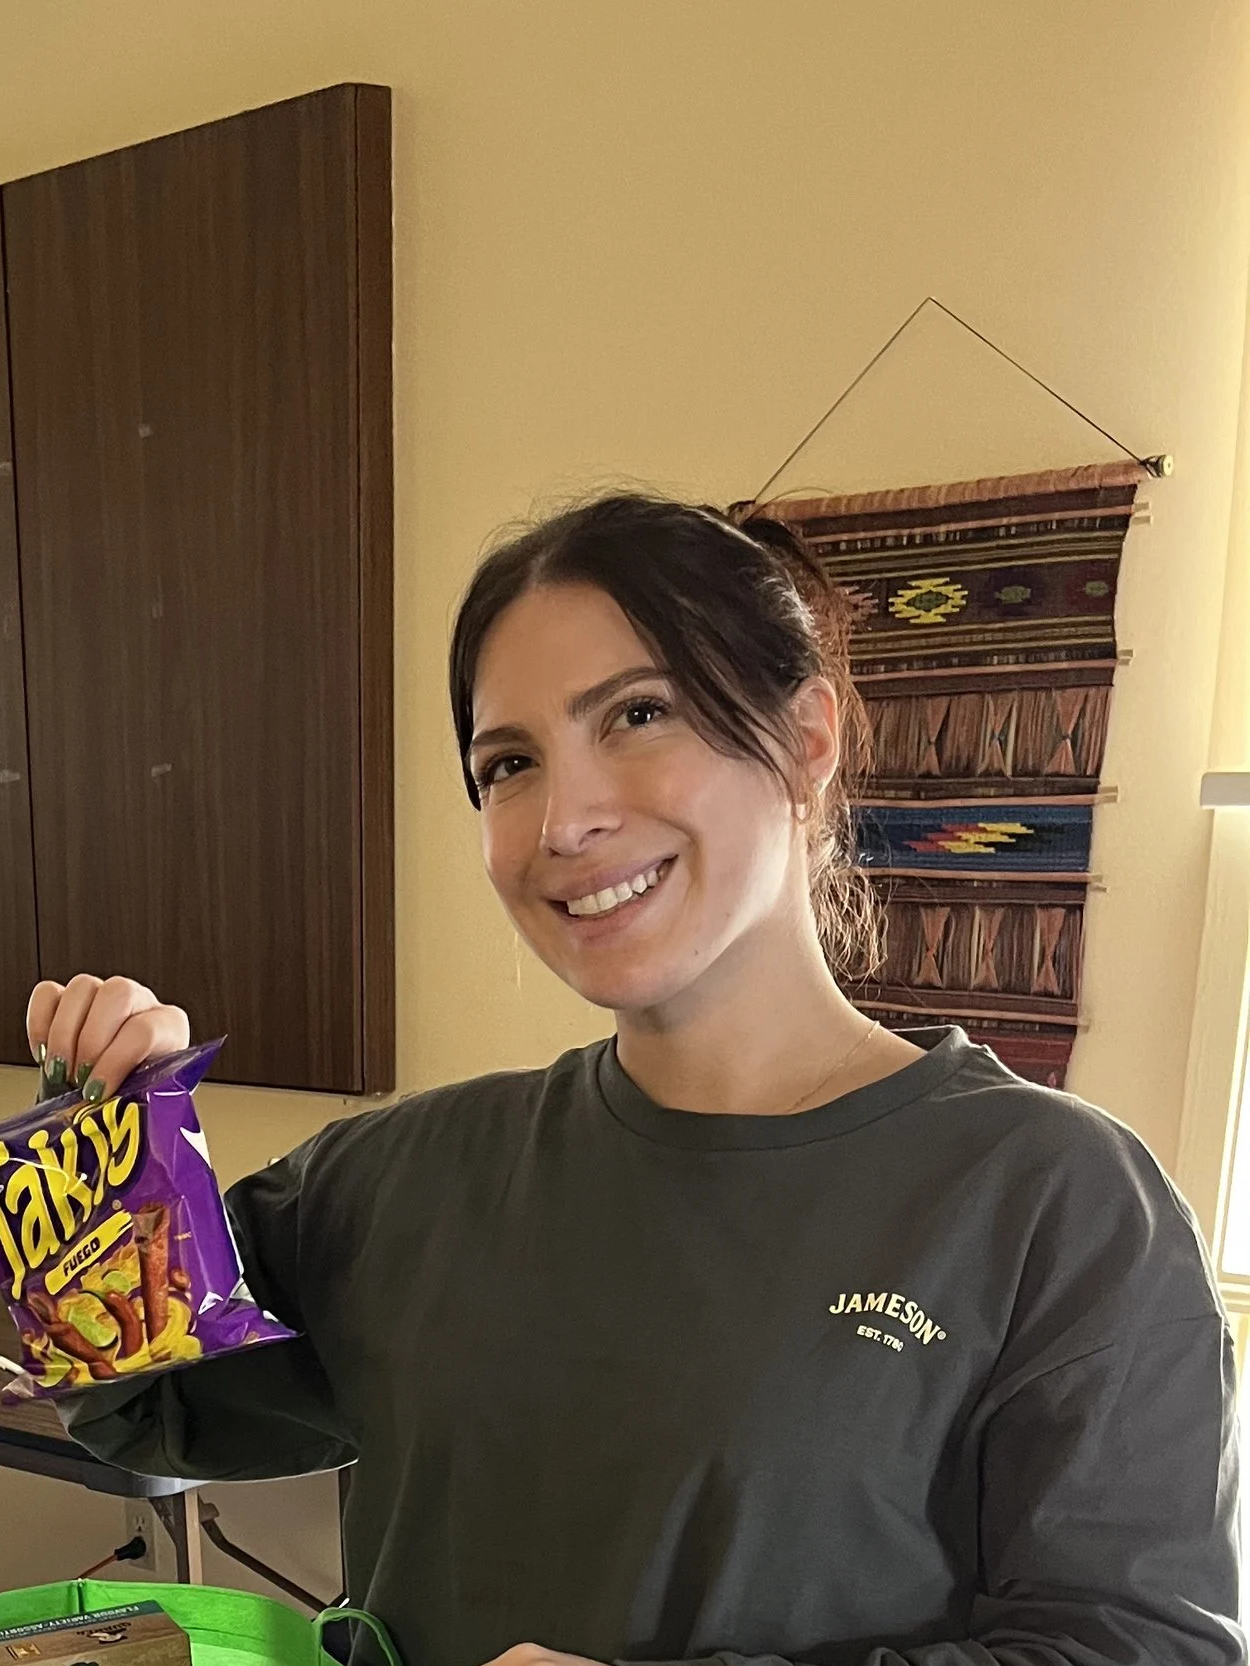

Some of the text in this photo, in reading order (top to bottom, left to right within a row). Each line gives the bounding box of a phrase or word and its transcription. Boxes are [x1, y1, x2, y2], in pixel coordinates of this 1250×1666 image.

[63, 1237, 100, 1277] FUEGO
[829, 1293, 940, 1344] JAMESON
[856, 1324, 881, 1341] EST.
